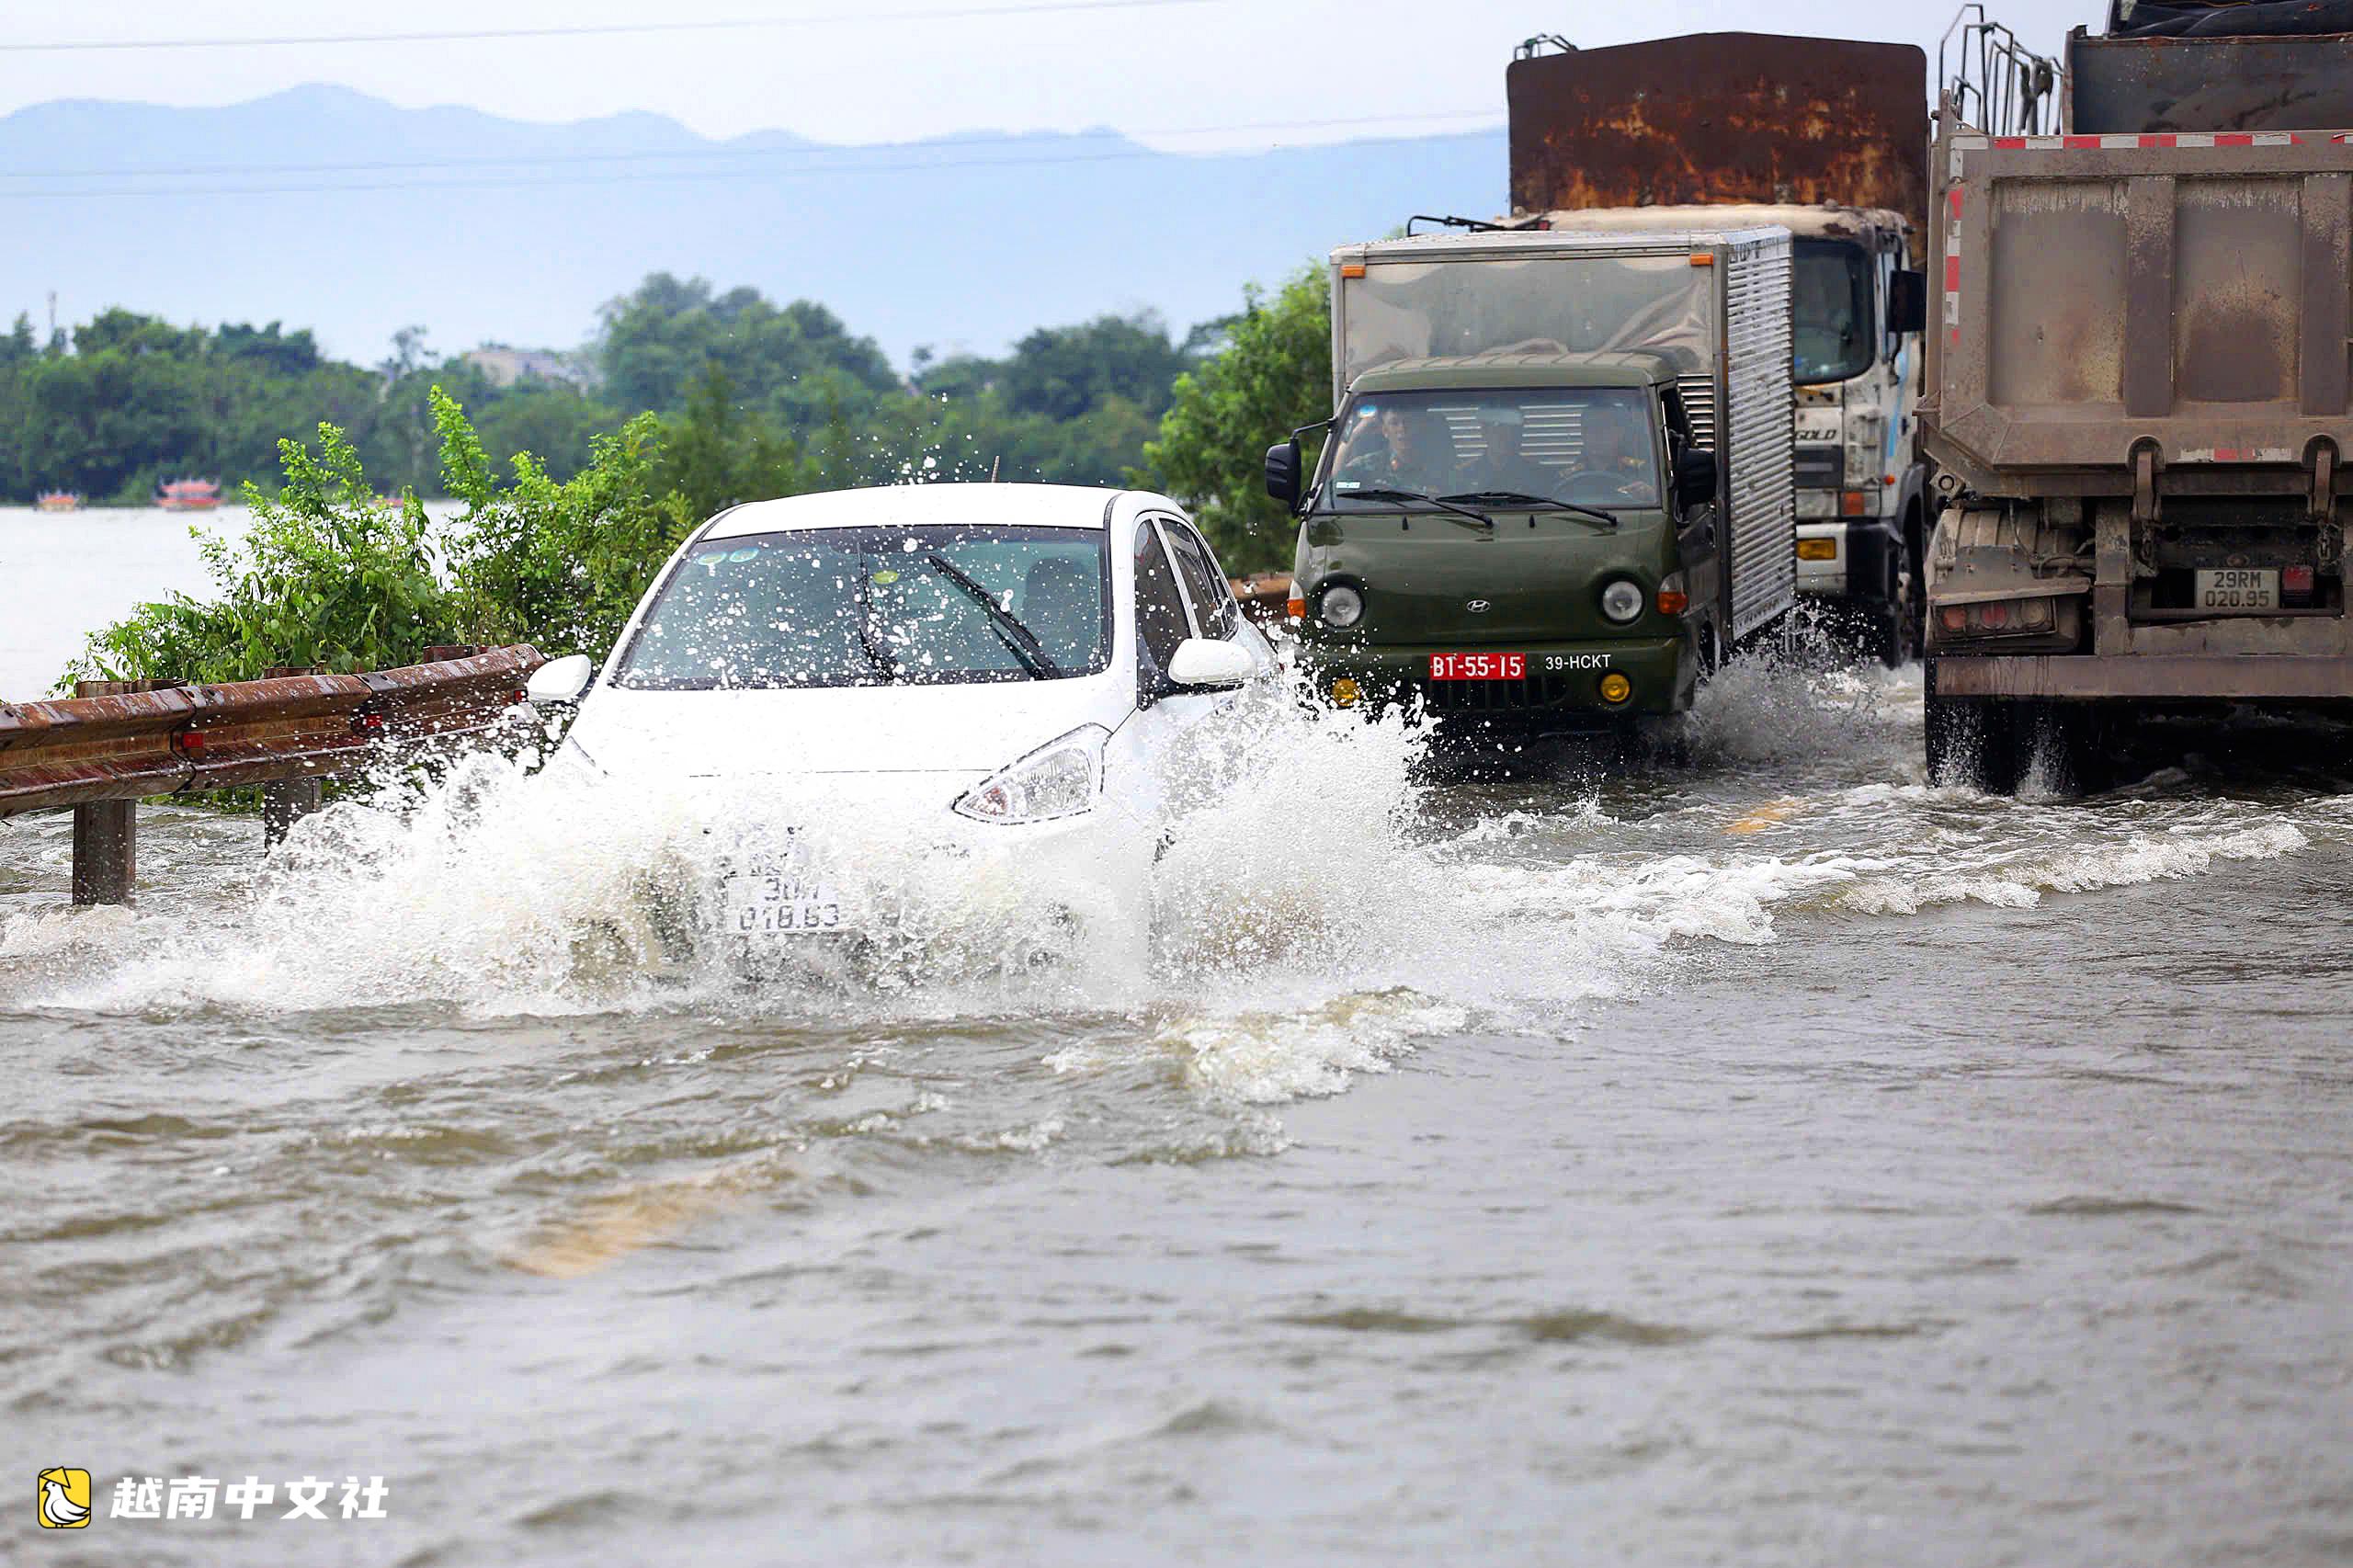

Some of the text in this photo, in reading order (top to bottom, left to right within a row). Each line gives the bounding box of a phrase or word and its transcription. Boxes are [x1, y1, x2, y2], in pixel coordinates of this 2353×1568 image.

[2213, 572, 2261, 588] 29RM
[2205, 590, 2269, 607] 020.95
[1433, 655, 1521, 677] BT-55-15
[1544, 653, 1611, 670] 39-HCKT
